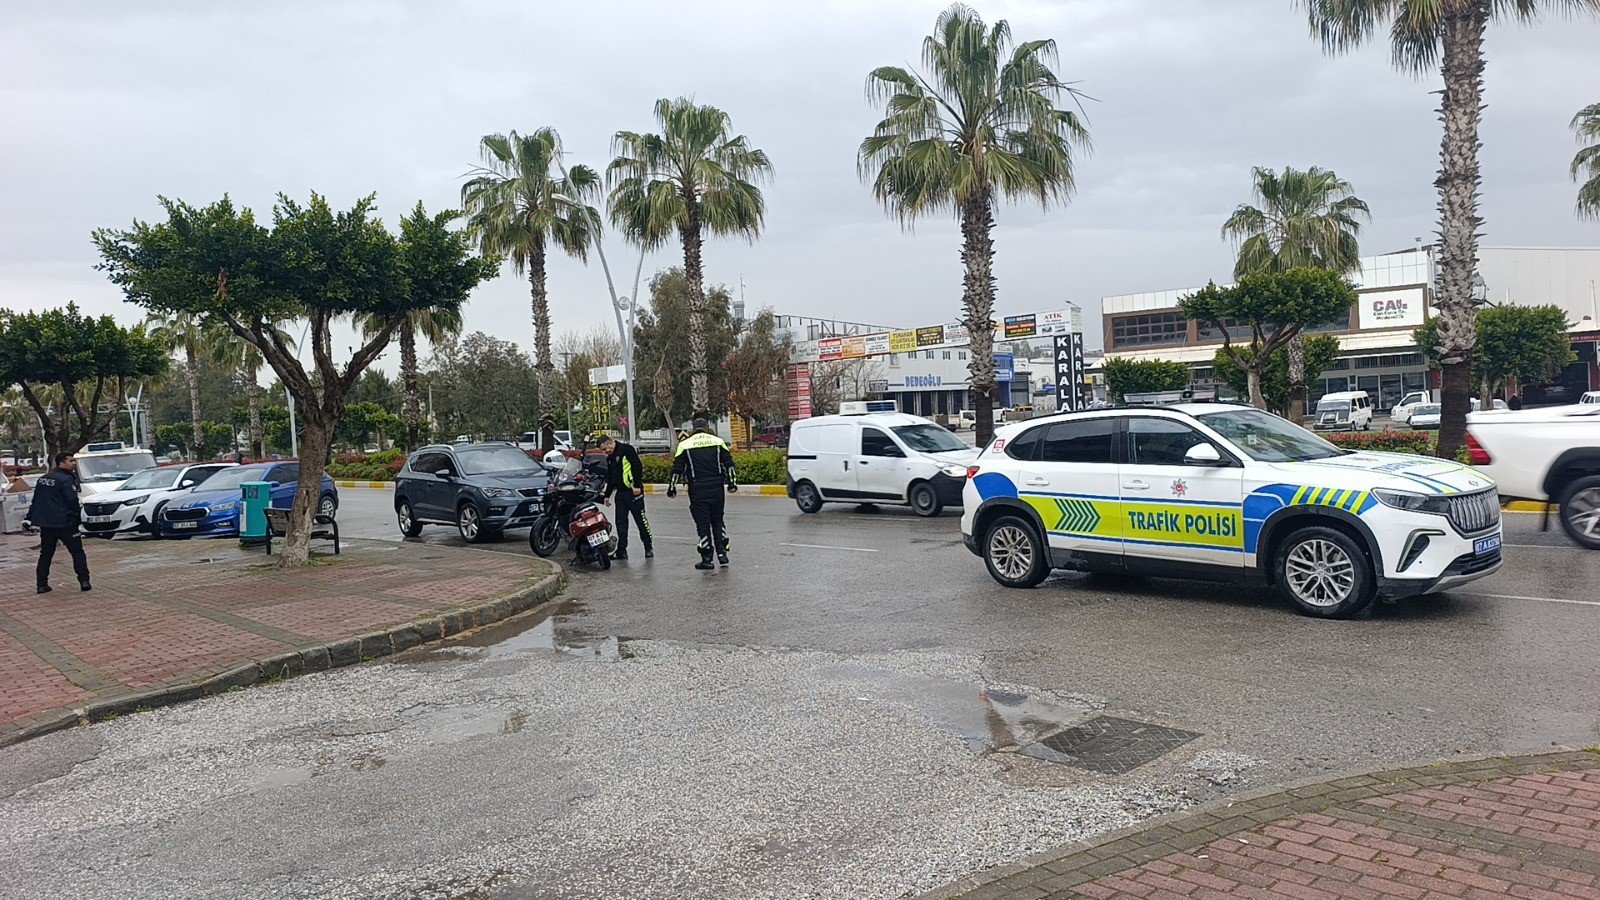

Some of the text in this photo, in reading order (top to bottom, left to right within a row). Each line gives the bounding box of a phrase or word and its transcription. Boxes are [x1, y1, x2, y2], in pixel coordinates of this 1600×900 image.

[905, 374, 941, 387] DEDEOĞLU
[1128, 510, 1236, 537] TRAFİK POLİSİ
[1483, 541, 1488, 550] A
